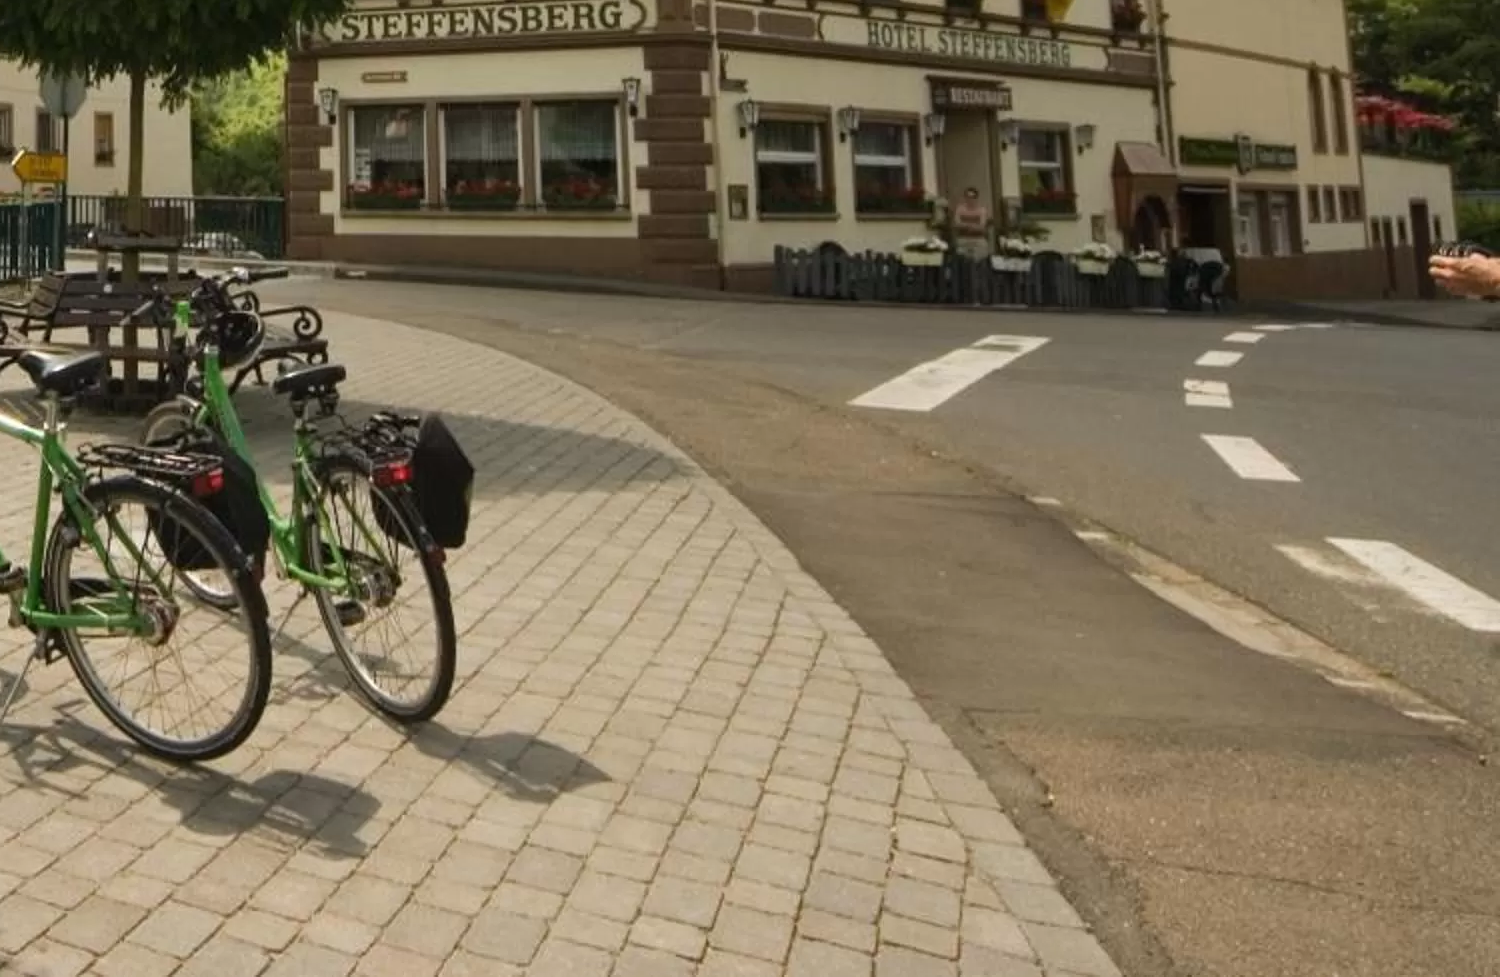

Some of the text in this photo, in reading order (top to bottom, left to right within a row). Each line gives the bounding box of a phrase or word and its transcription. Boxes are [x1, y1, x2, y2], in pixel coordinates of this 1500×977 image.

[341, 0, 623, 41] STEFFENSBERG
[867, 22, 1071, 68] HOTEL STEFFENSBERG
